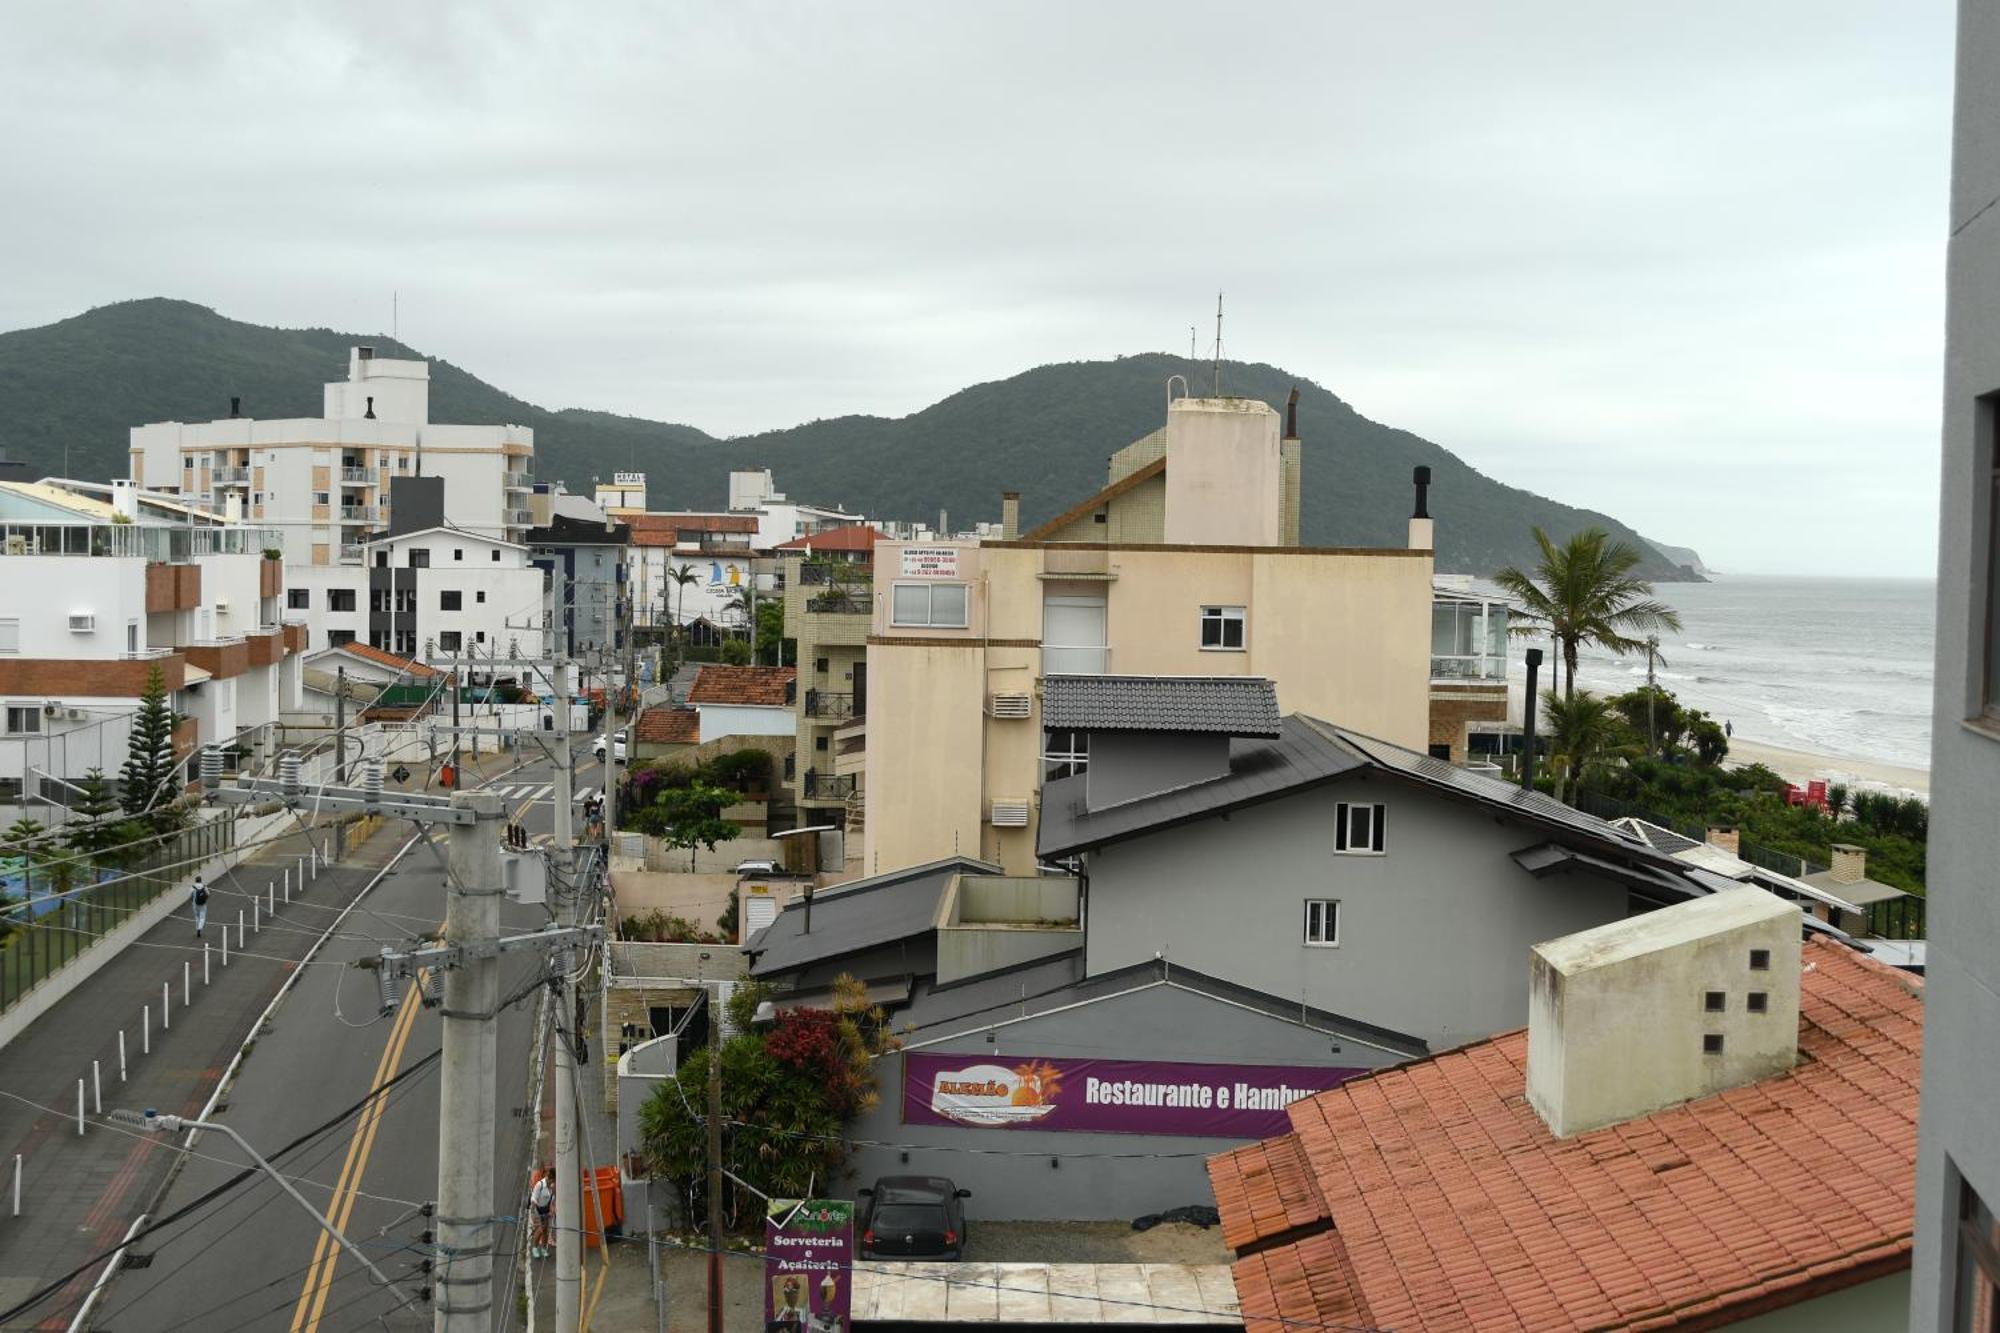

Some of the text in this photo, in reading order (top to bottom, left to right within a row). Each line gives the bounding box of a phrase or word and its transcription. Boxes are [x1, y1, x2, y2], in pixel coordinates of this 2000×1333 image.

[938, 1080, 1009, 1098] ALEMÃO
[1086, 1077, 1212, 1109] Restaurante
[1217, 1090, 1229, 1109] e
[774, 1236, 843, 1246] Sorveteria
